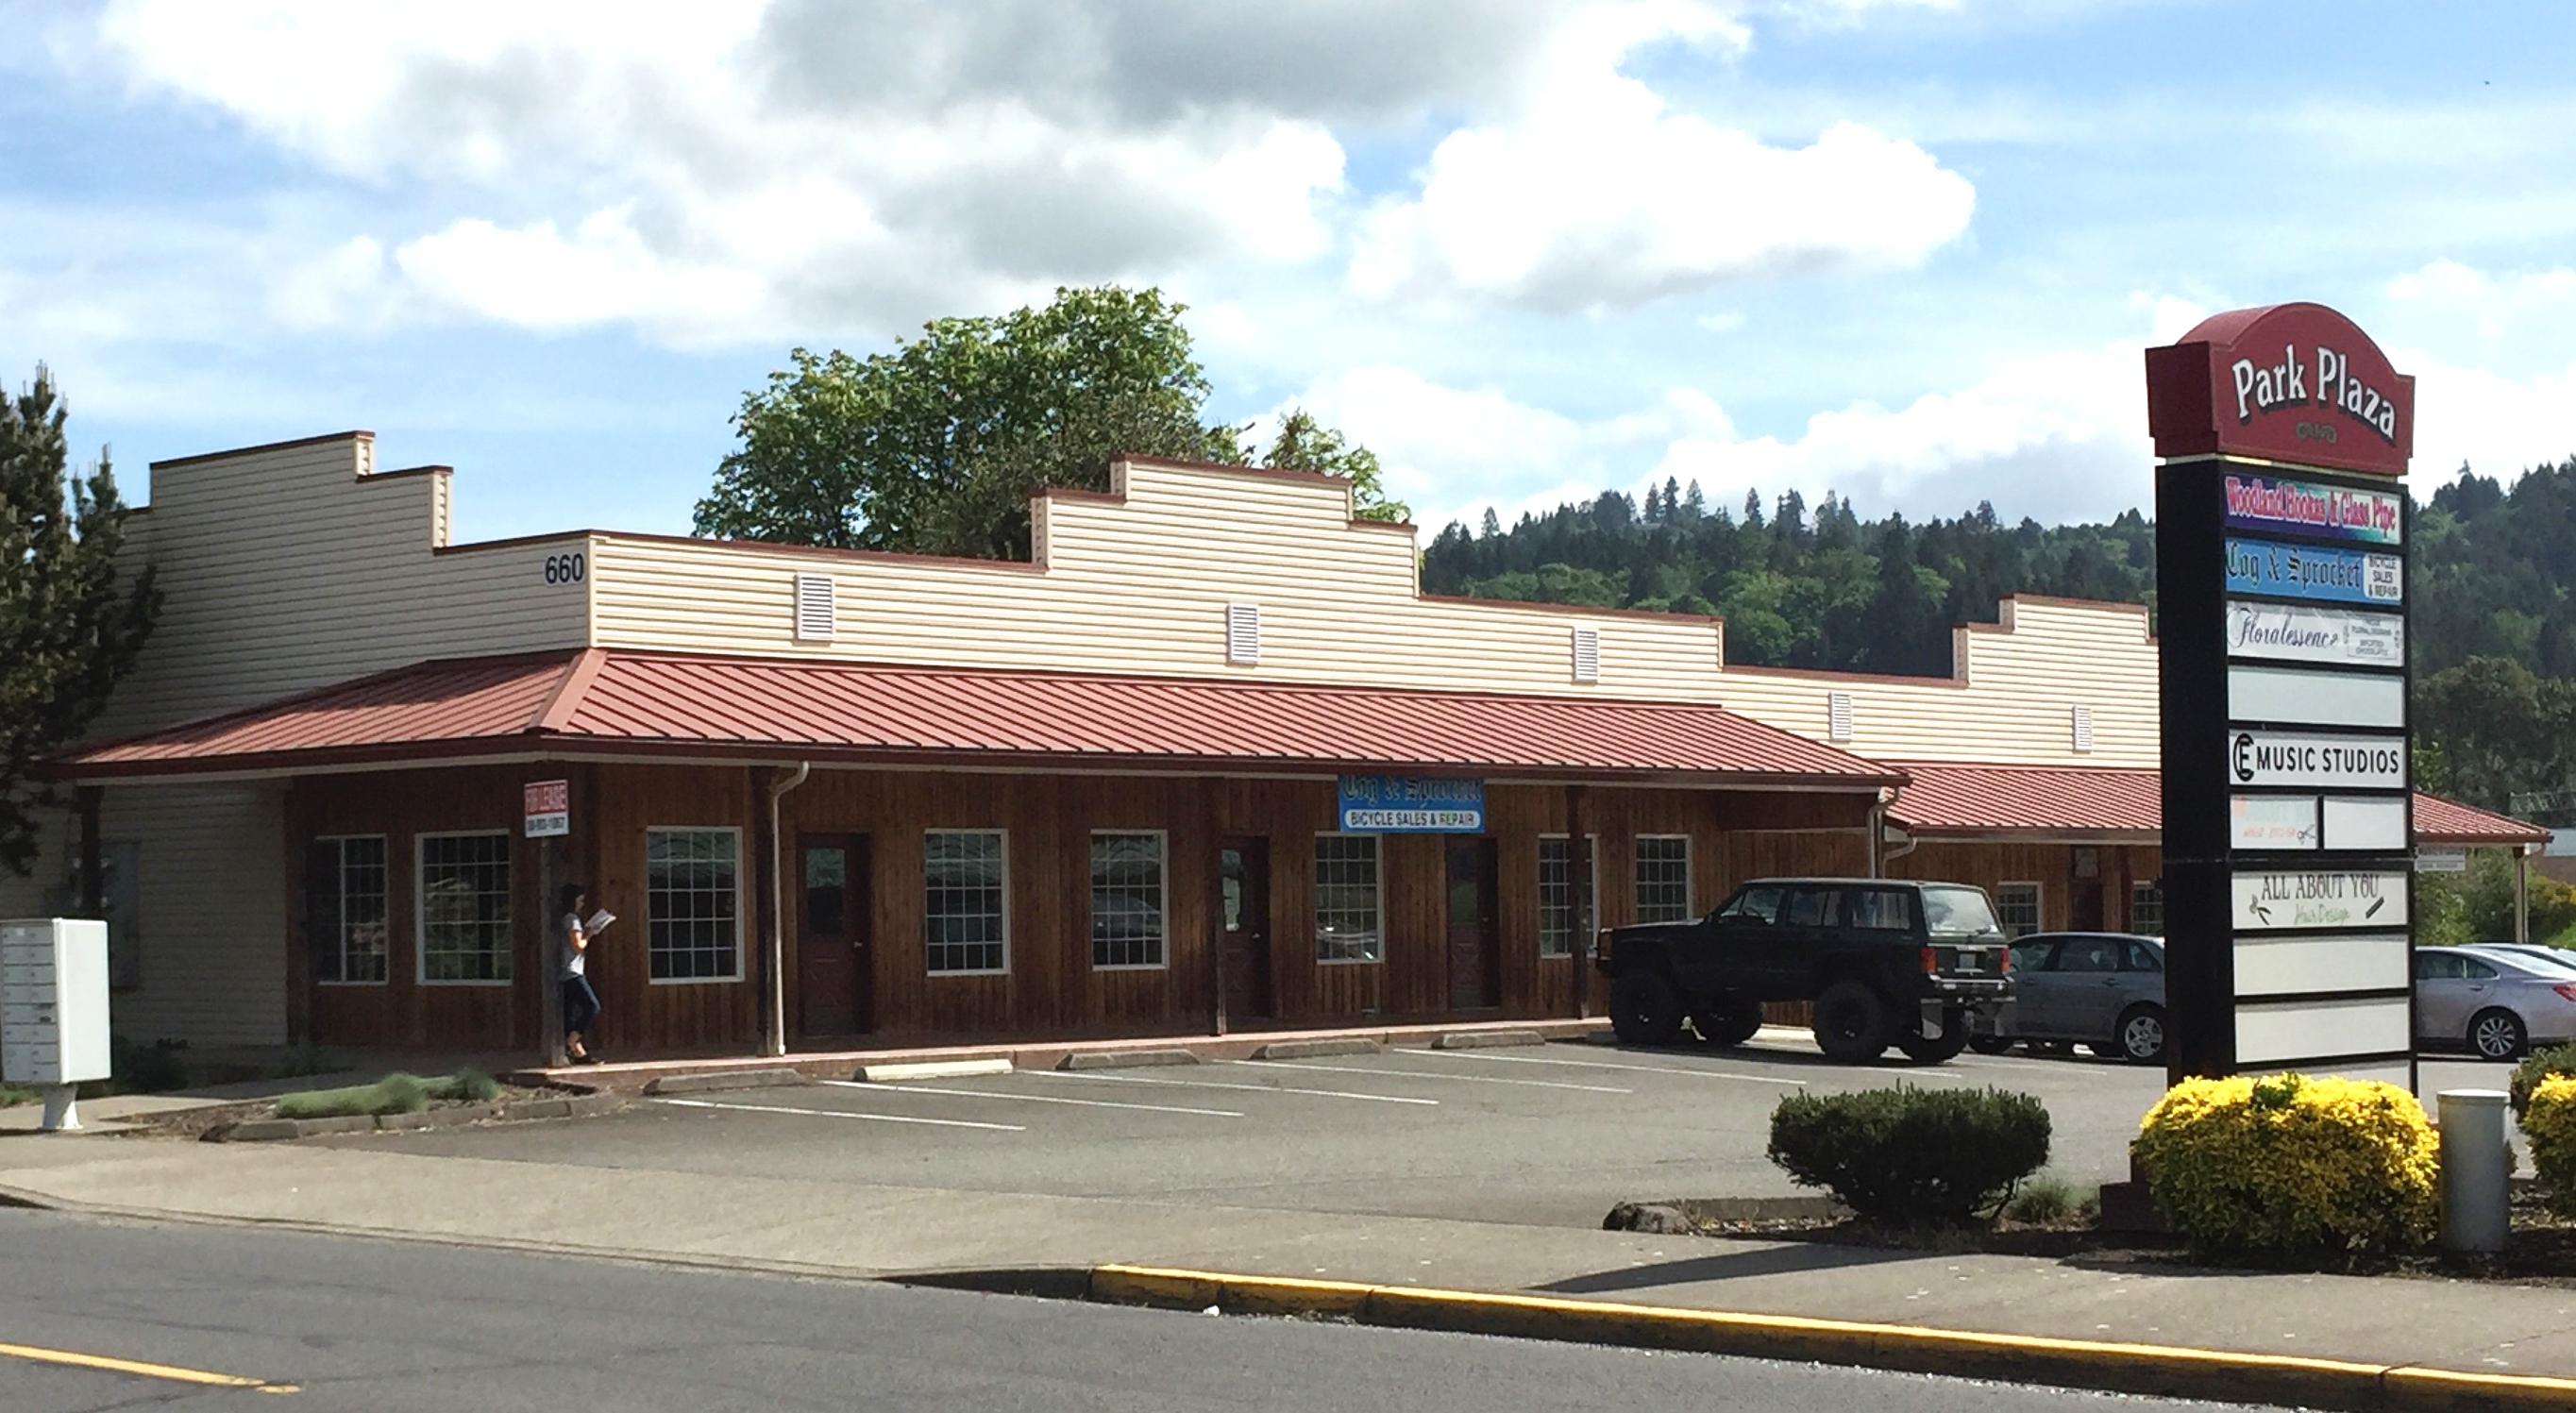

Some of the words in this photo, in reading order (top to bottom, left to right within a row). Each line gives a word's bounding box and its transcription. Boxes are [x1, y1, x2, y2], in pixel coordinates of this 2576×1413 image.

[2231, 344, 2307, 418] Park
[2317, 346, 2396, 440] Plaza
[2226, 477, 2283, 520] Woodland
[2342, 492, 2369, 527] Glass
[2372, 495, 2396, 539] Pipe
[546, 553, 584, 584] 660
[2227, 542, 2259, 586] Cog
[2267, 547, 2280, 581] &
[2288, 547, 2361, 592] Sprocket
[2373, 570, 2393, 584] SALES
[2375, 584, 2399, 597] REPAIR
[2233, 607, 2339, 648] Floralessence
[2257, 746, 2315, 772] MUSIC
[2322, 748, 2399, 774] STUDIOS
[1351, 812, 1393, 826] BICYCLE
[1395, 812, 1427, 826] SALES
[1430, 813, 1437, 826] &
[1440, 813, 1474, 827] REPAIR
[2262, 874, 2290, 900] ALL
[2296, 873, 2345, 900] ABOUT
[2349, 873, 2380, 899] YOU
